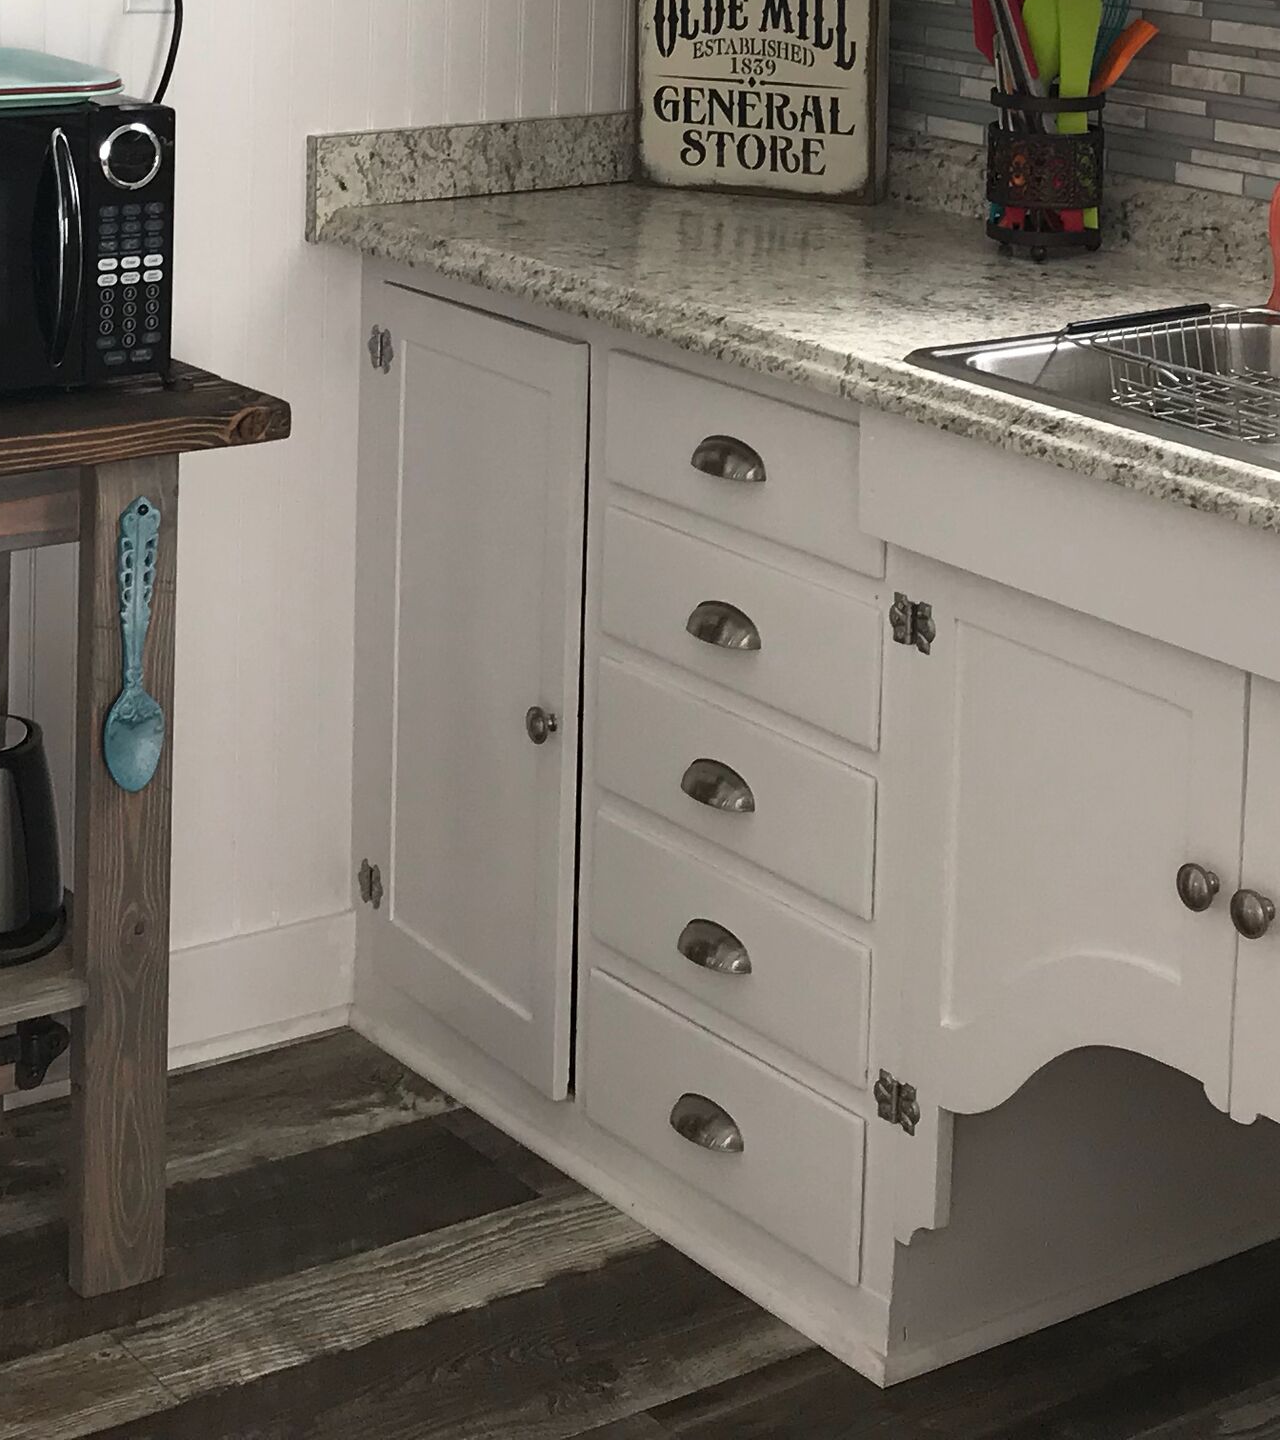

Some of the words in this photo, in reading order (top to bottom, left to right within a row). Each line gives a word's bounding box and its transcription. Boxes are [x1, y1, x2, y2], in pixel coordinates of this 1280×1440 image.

[693, 37, 815, 67] ESTABLISHED
[730, 57, 777, 77] 1839
[653, 85, 856, 136] GENERAL
[680, 129, 826, 176] STORE
